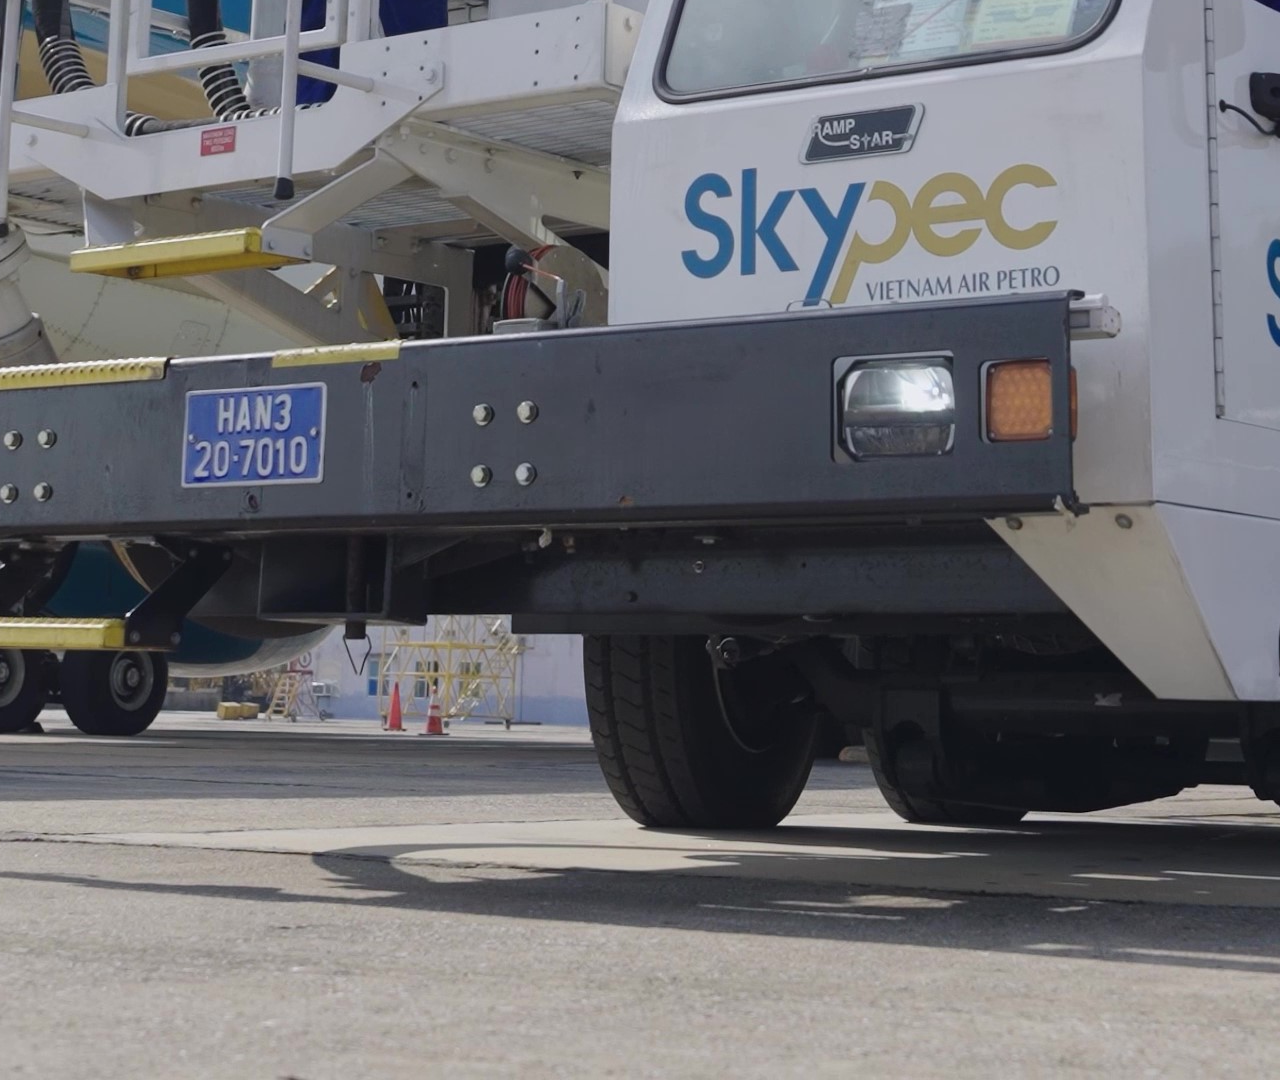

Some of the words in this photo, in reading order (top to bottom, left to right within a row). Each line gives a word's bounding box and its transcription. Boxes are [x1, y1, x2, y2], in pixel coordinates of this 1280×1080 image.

[812, 119, 856, 137] RAMP
[849, 130, 894, 151] STAR
[681, 163, 1058, 307] Skypec
[866, 275, 953, 301] VIETNAM
[958, 272, 990, 293] AIR
[997, 266, 1060, 290] PETRO
[217, 393, 292, 433] HAN3
